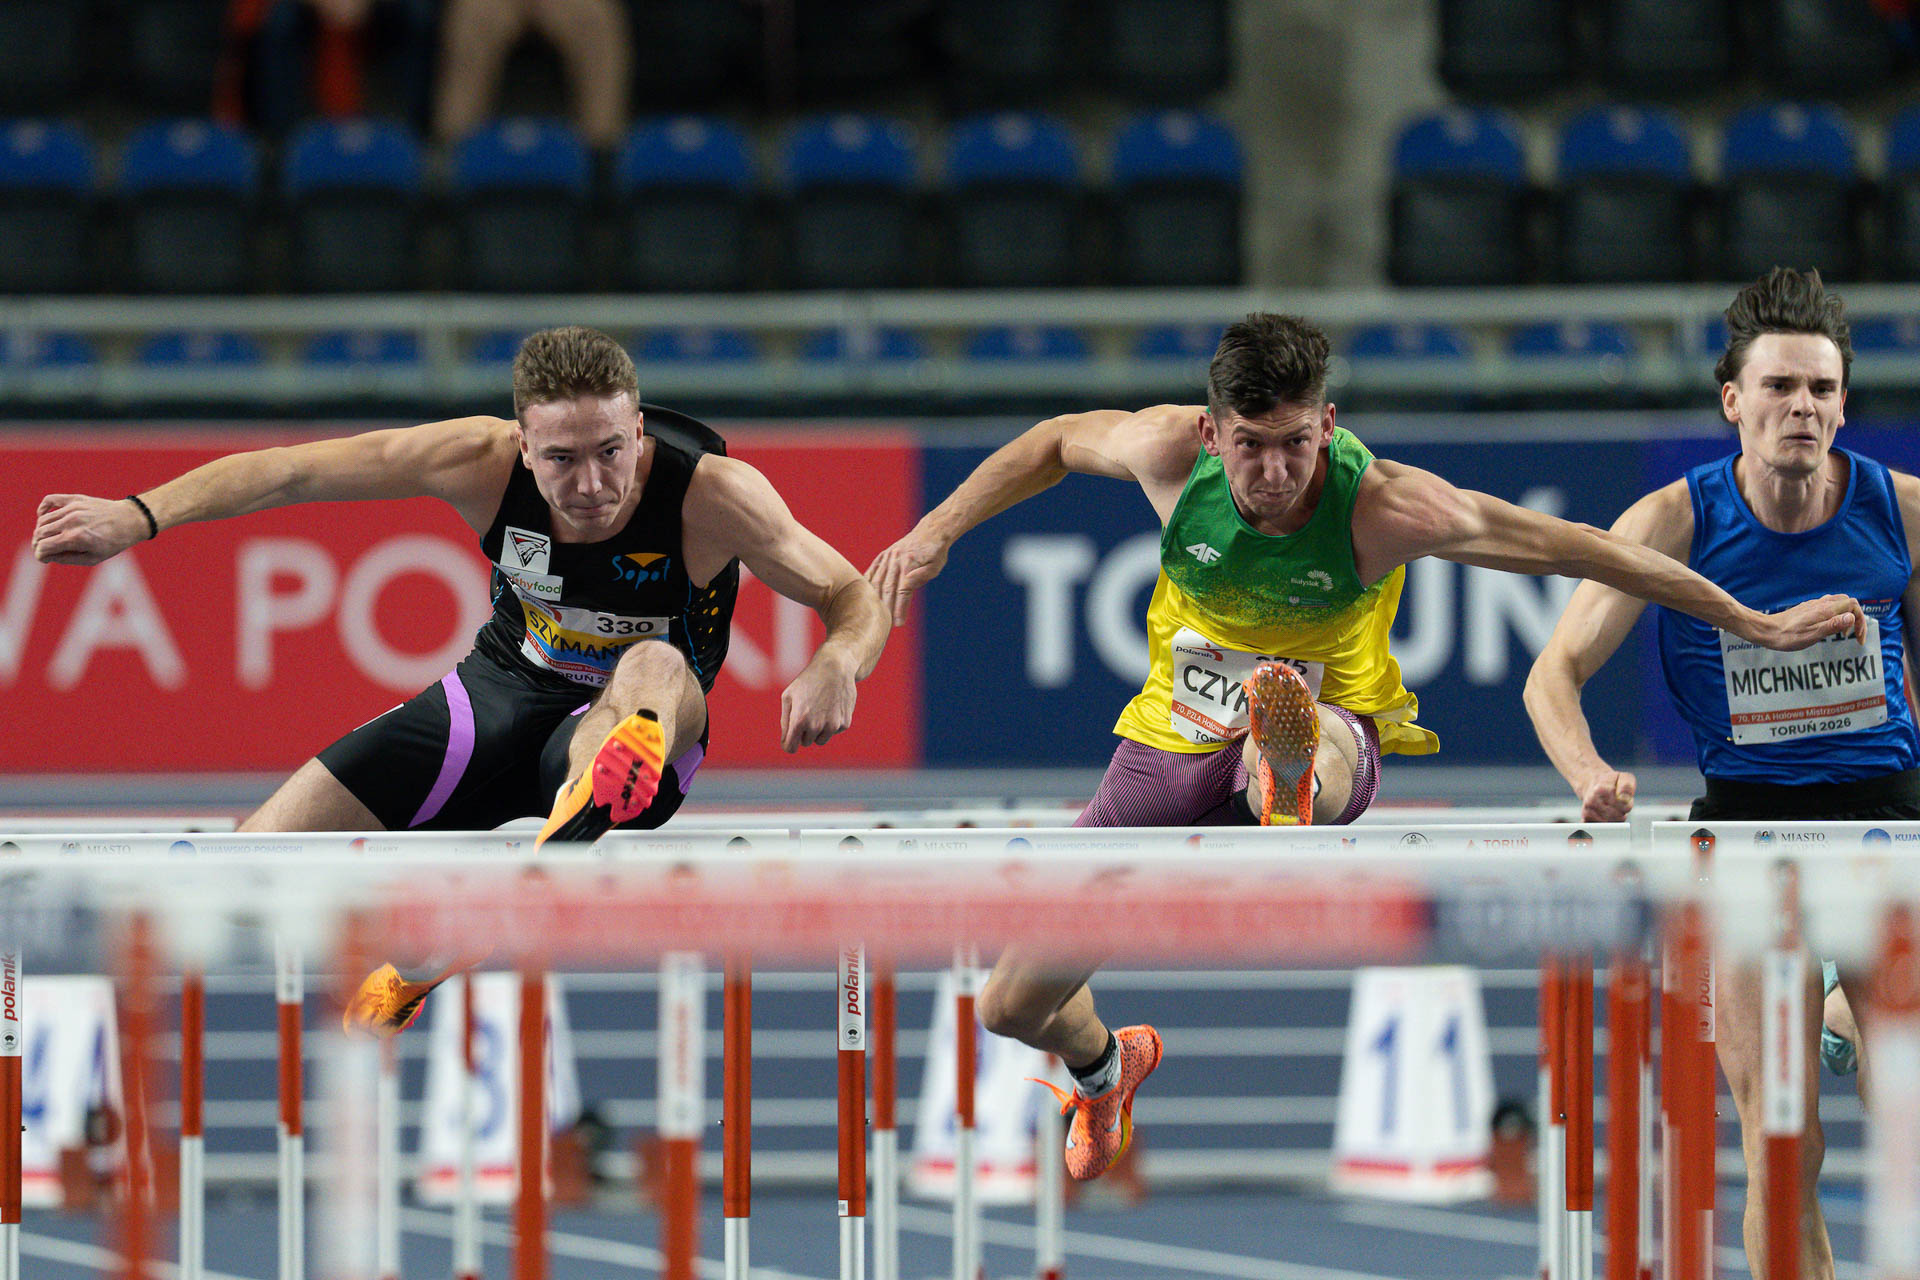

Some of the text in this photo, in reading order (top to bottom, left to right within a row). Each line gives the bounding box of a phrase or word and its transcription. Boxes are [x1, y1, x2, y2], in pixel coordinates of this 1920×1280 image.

[610, 554, 671, 591] Sopot
[528, 610, 628, 661] SZYMAŃ
[596, 616, 655, 635] 330
[1175, 645, 1214, 660] polanik
[1731, 655, 1877, 697] MICHNIEWSKI
[1176, 703, 1187, 716] 70.
[1186, 710, 1202, 724] PZLA
[1202, 716, 1226, 737] Halowe
[1751, 713, 1771, 722] PZLA
[1772, 709, 1805, 721] Halowe
[1806, 704, 1856, 718] Mistrzostwa
[1856, 698, 1881, 712] Polski
[1770, 717, 1852, 737] TORUŃ 2026
[87, 844, 132, 855] MIASTO
[1781, 831, 1826, 842] MIASTO
[2, 952, 18, 1023] polanik
[844, 945, 862, 1017] polanik
[1369, 1013, 1403, 1136] 1
[1436, 1013, 1471, 1133] 1
